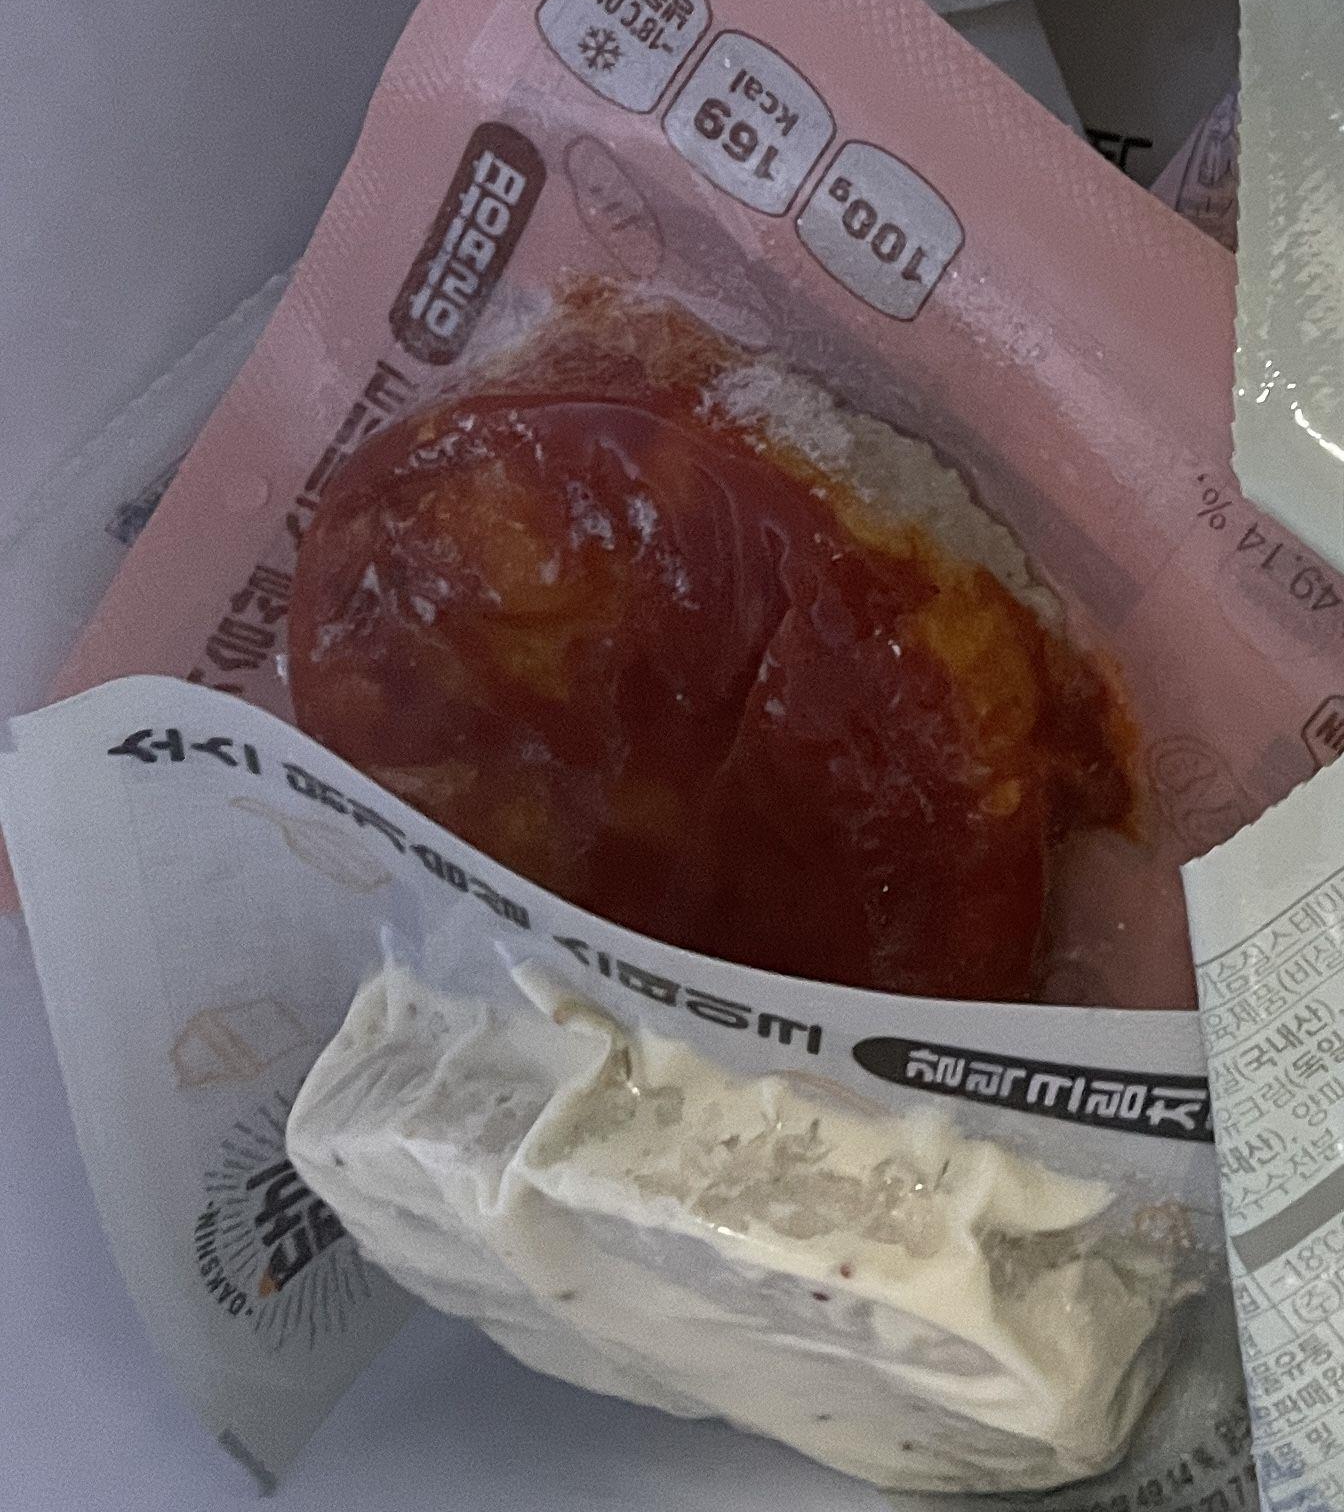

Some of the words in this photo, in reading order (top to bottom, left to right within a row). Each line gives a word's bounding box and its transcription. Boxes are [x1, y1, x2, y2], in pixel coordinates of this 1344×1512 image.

[694, 98, 779, 180] 169
[729, 69, 799, 137] kcal
[829, 177, 926, 282] 100g
